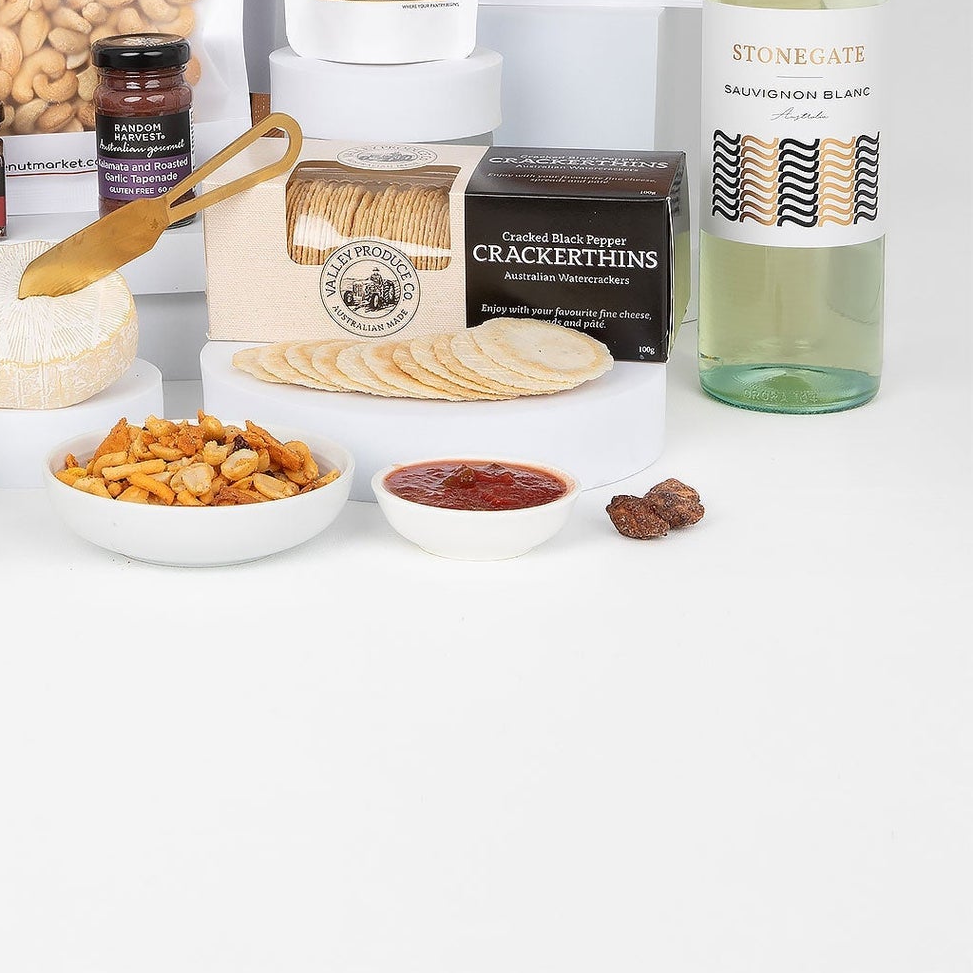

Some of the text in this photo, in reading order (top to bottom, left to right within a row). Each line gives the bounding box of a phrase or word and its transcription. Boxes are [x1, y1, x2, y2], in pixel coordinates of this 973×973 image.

[732, 43, 866, 66] STONEGATE
[724, 84, 870, 100] SAUVIGNON BLANC
[114, 123, 161, 132] RANDOM
[99, 138, 146, 153] Australian
[131, 162, 151, 172] and
[154, 158, 189, 171] Roasted
[488, 156, 669, 169] CRACKERTHINS
[105, 172, 178, 184] Garlic Tapenade
[109, 186, 168, 195] GLUTEN FREE 60
[502, 231, 627, 248] Cracked Black Pepper
[472, 244, 658, 269] CRACKERTHINS
[325, 249, 353, 298] VALLEY
[354, 245, 412, 281] PRODUCE
[504, 271, 630, 285] Australian Watercrackers
[332, 305, 408, 332] AUSTRALIAN MADE
[481, 304, 652, 321] Enjoy with your favourite fine cheese,
[563, 319, 582, 328] and
[583, 319, 607, 329] pâté.
[638, 346, 656, 355] 100g
